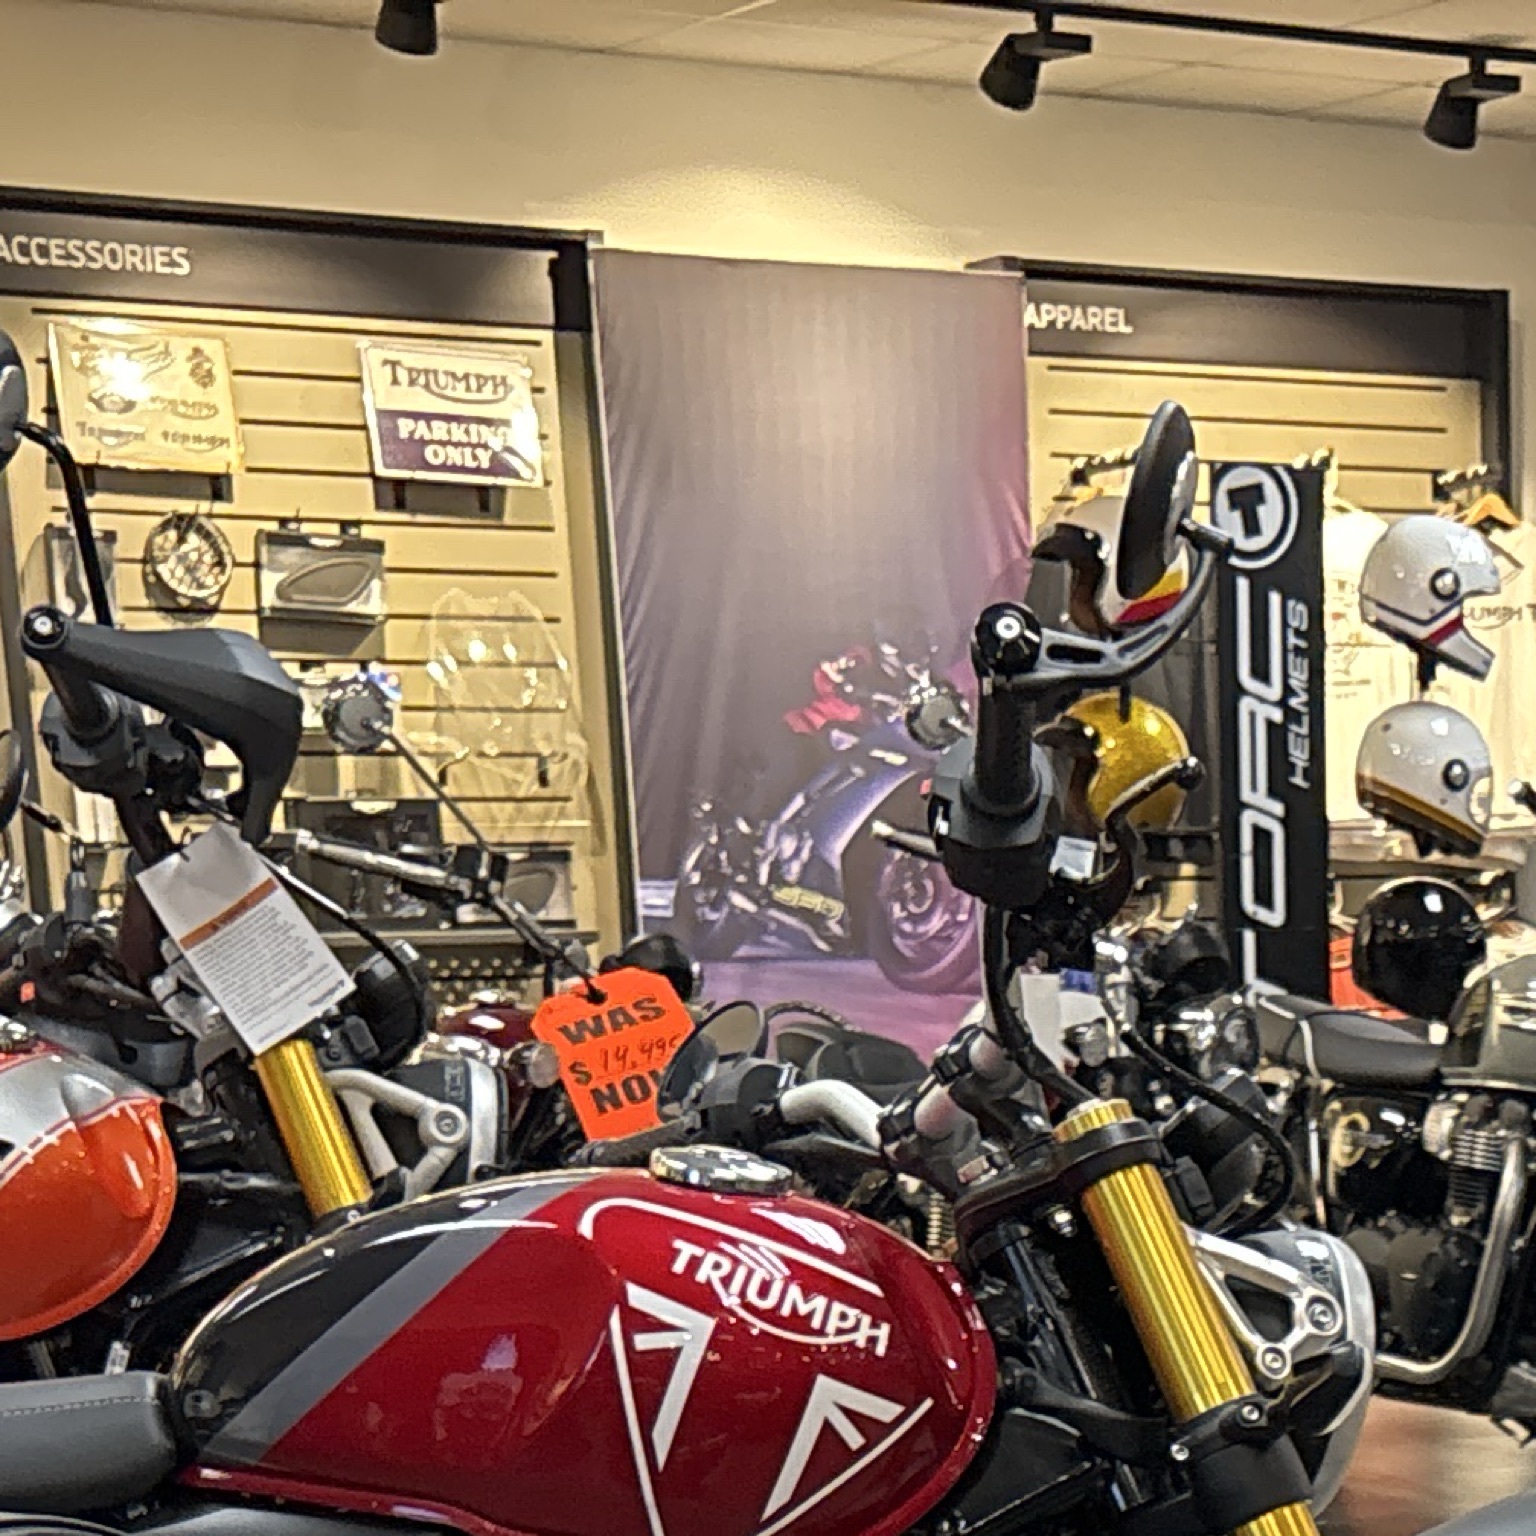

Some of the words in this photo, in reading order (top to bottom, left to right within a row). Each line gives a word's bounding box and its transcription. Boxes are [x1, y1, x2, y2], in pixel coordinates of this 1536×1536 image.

[1024, 301, 1135, 334] APPAREL
[381, 357, 511, 398] TRIUMPH
[423, 444, 493, 469] ONLY
[1286, 599, 1312, 790] HELMETS
[557, 997, 666, 1046] WAS
[669, 1236, 892, 1358] TRIUMPH
